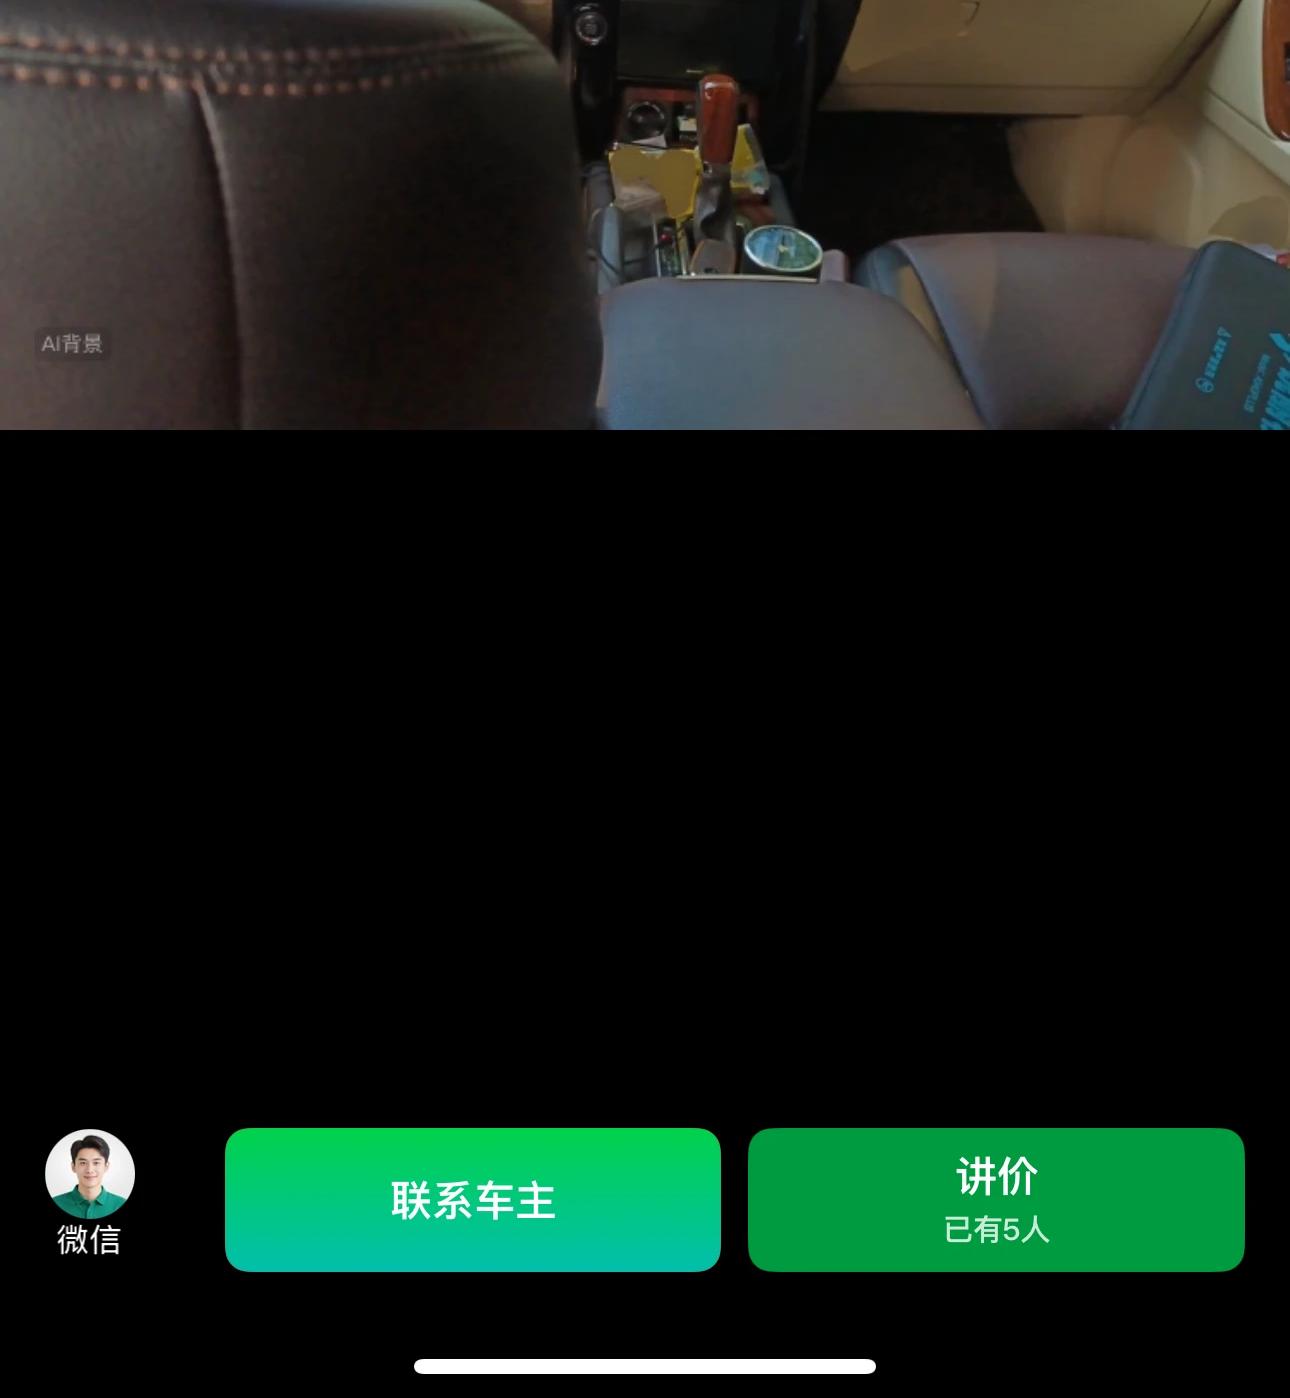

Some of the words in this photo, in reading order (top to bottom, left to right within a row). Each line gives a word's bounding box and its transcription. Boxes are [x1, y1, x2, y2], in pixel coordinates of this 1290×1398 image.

[956, 1156, 1038, 1196] 讲价
[391, 1180, 555, 1220] 联系车主
[57, 1224, 122, 1256] 微信
[945, 1214, 1050, 1244] 已有5人
